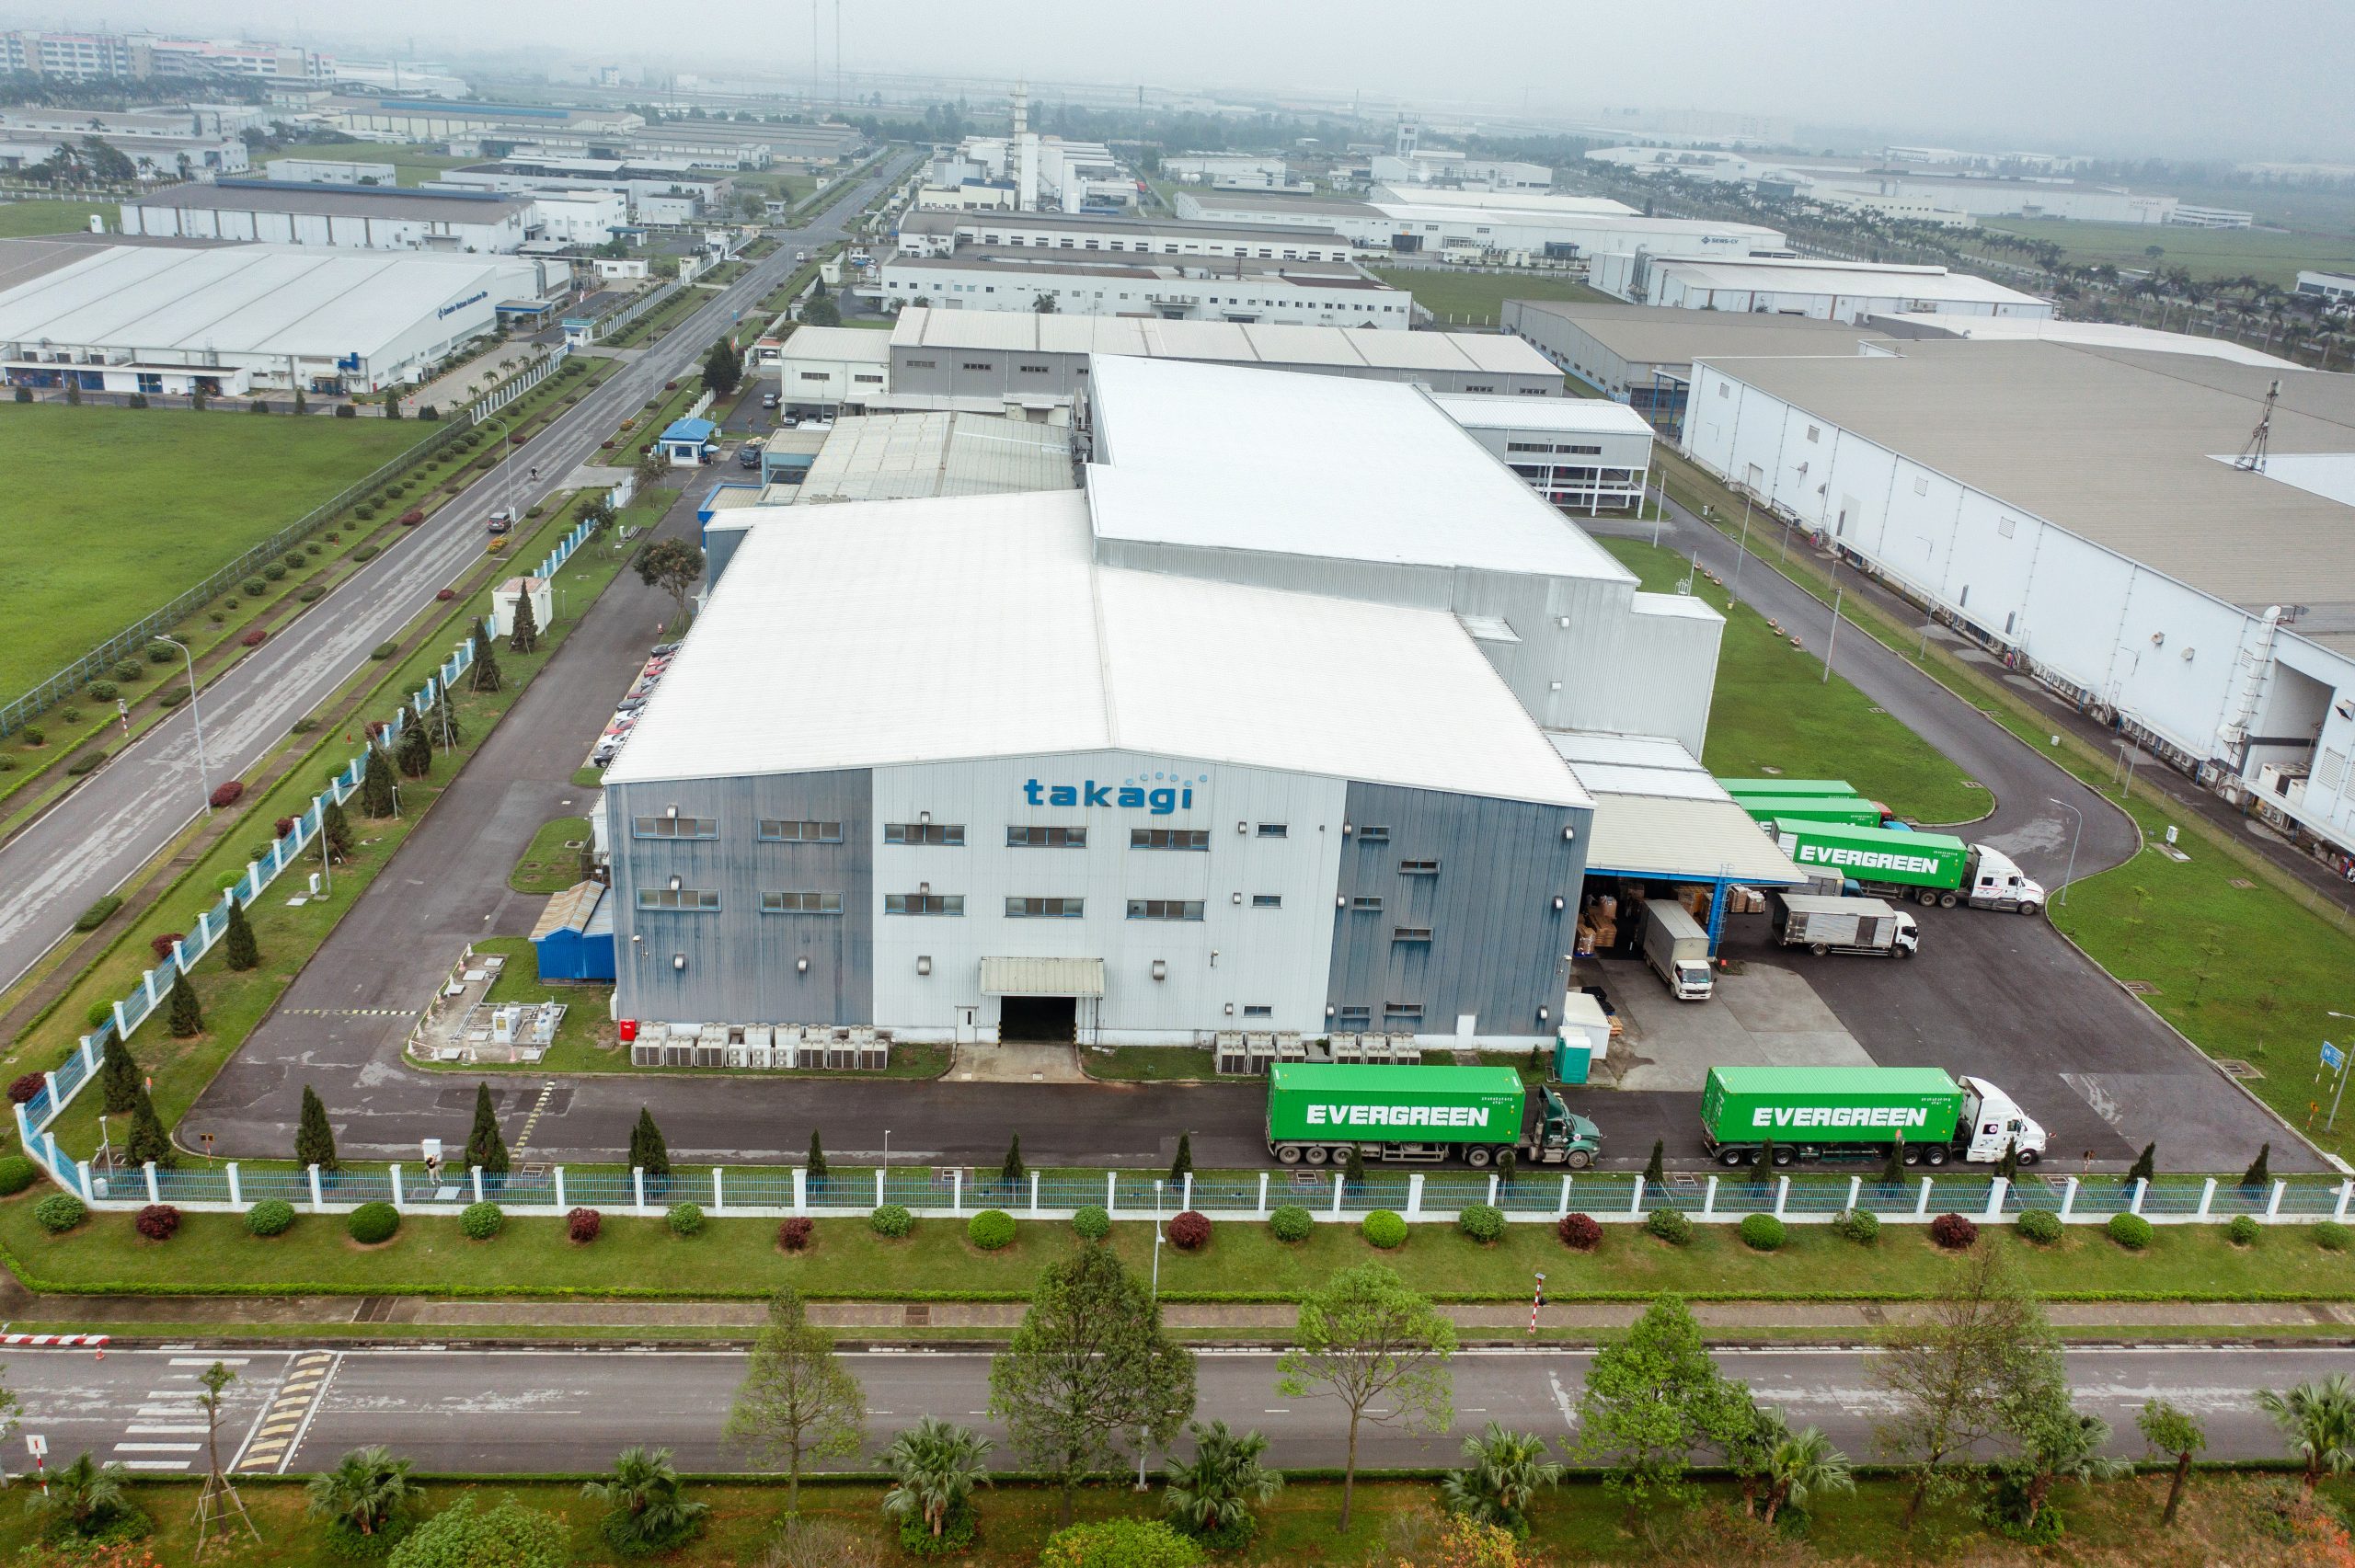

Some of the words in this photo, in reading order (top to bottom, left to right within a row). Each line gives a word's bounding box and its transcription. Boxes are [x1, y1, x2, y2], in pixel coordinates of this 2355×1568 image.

[1023, 778, 1193, 815] takagi
[1799, 845, 1938, 875] EVERGREEN
[1306, 1104, 1489, 1127] EVERGREEN
[1752, 1107, 1928, 1127] EVERGREEN
